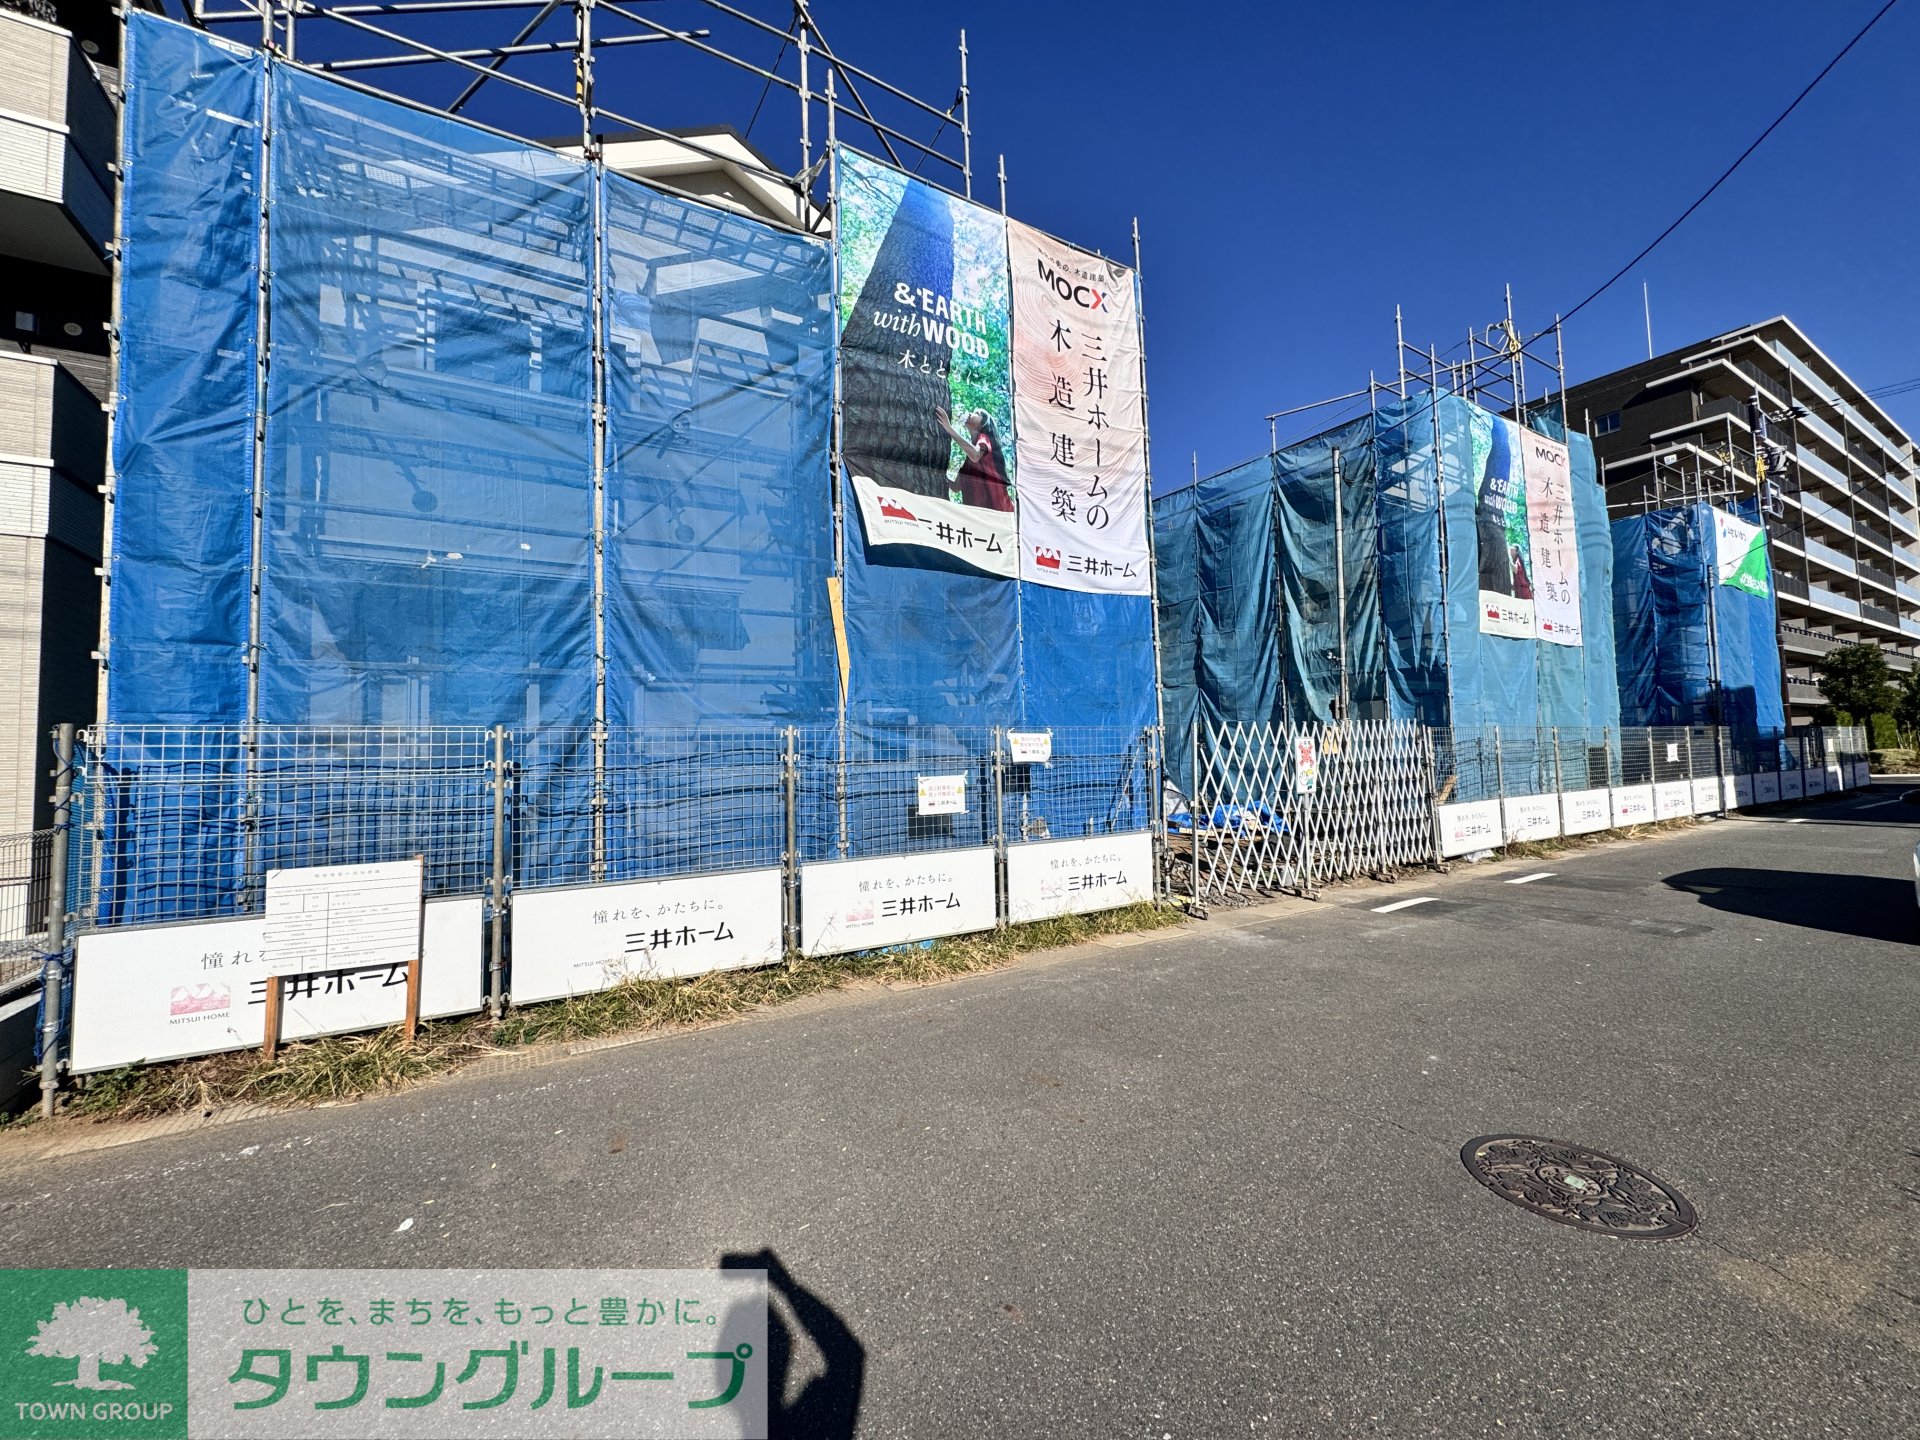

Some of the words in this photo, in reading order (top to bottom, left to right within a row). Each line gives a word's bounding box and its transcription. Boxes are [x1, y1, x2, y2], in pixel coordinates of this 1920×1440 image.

[1037, 258, 1109, 313] MOCX
[873, 309, 921, 337] with
[922, 316, 990, 359] WOOD
[1048, 319, 1077, 523] 木造建築
[1081, 332, 1110, 530] 三井ホームの
[1540, 477, 1558, 602] 木造建築
[1553, 482, 1571, 605] 三井ホームの
[1067, 555, 1137, 578] 三井ホーム
[1501, 608, 1530, 625] 三井ホーム
[1465, 823, 1491, 837] 三井ホーム
[858, 872, 953, 892] 憧れを、かたちに。
[1068, 871, 1127, 891] 三井ホーム
[592, 899, 724, 925] 憧れを、かたちに。
[881, 892, 960, 917] 三井ホーム
[624, 921, 734, 953] 三井ホーム
[169, 1016, 200, 1026] MITSUI
[203, 1011, 230, 1022] HOME
